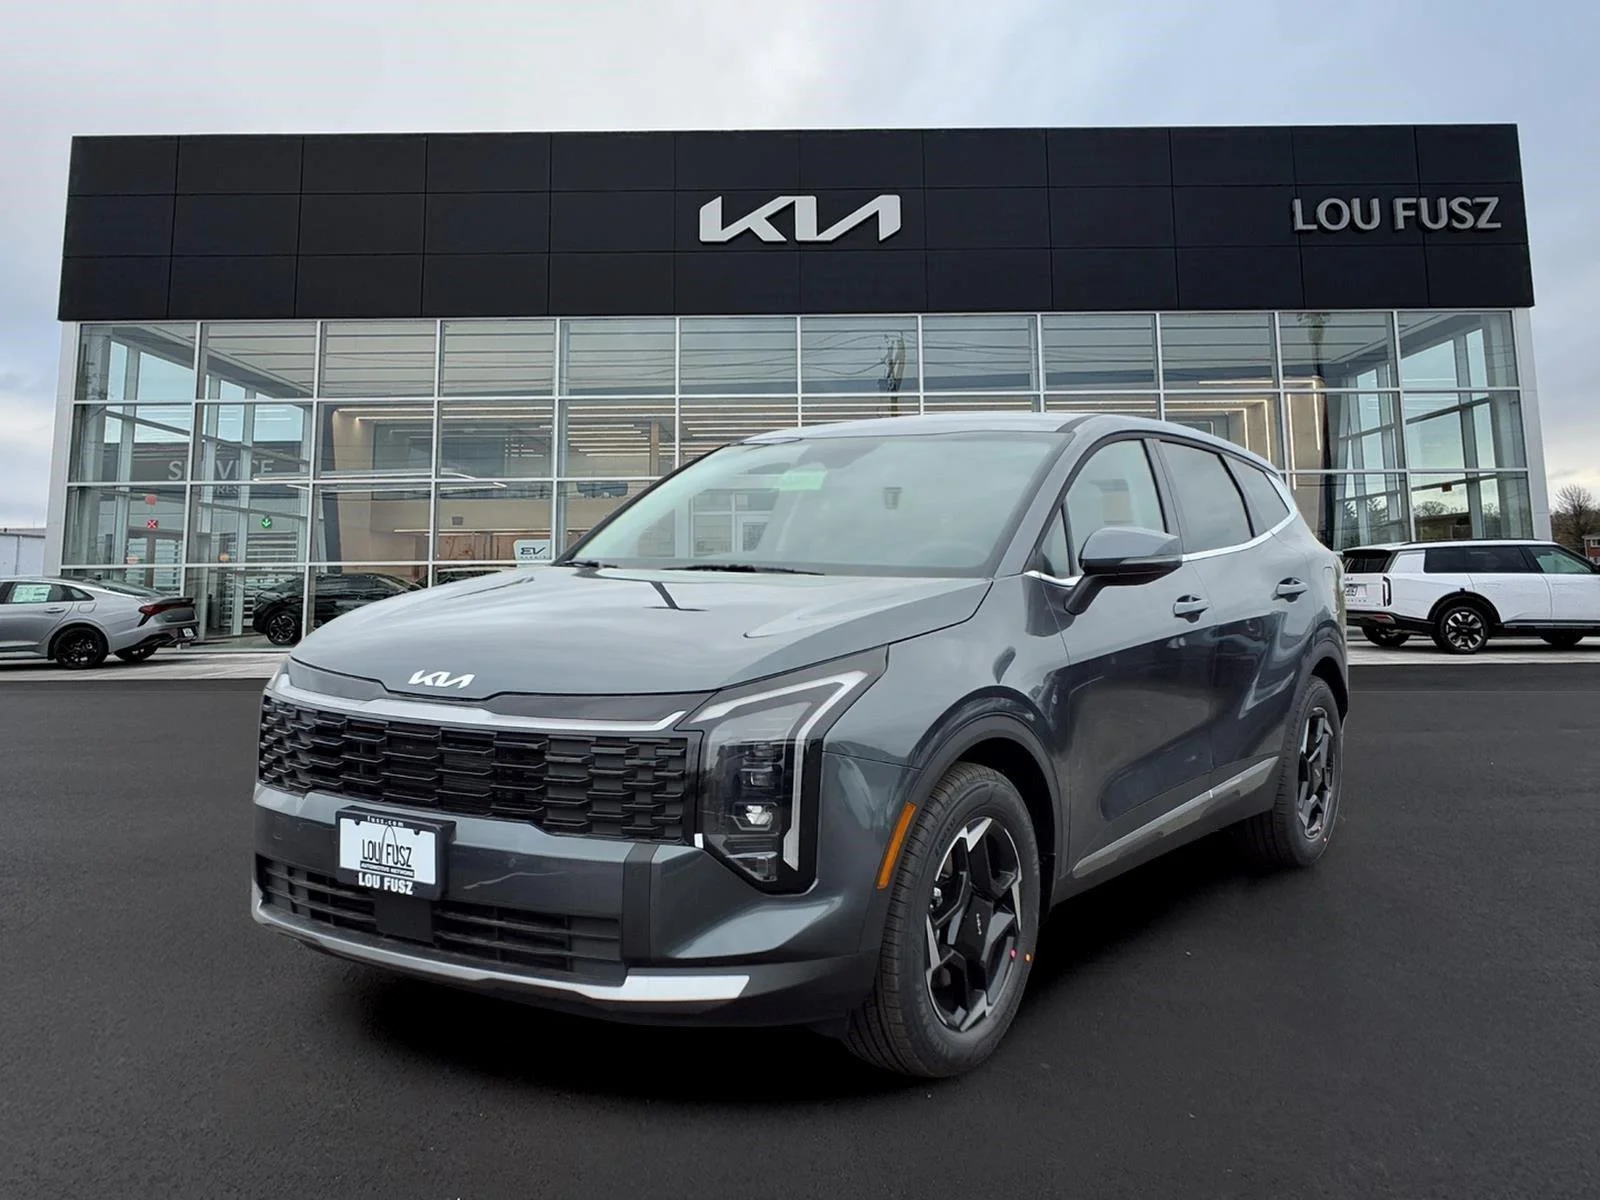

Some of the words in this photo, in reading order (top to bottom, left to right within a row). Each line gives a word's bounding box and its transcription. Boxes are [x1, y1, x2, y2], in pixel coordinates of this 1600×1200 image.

[699, 194, 901, 242] KIA
[1293, 197, 1381, 231] LOU
[1393, 196, 1502, 230] FUSZ
[168, 459, 274, 480] SVIE
[408, 669, 475, 689] KIA
[362, 839, 381, 862] LOU
[386, 843, 412, 868] FUSZ
[358, 872, 381, 889] LOU
[384, 877, 413, 895] FUSZ
